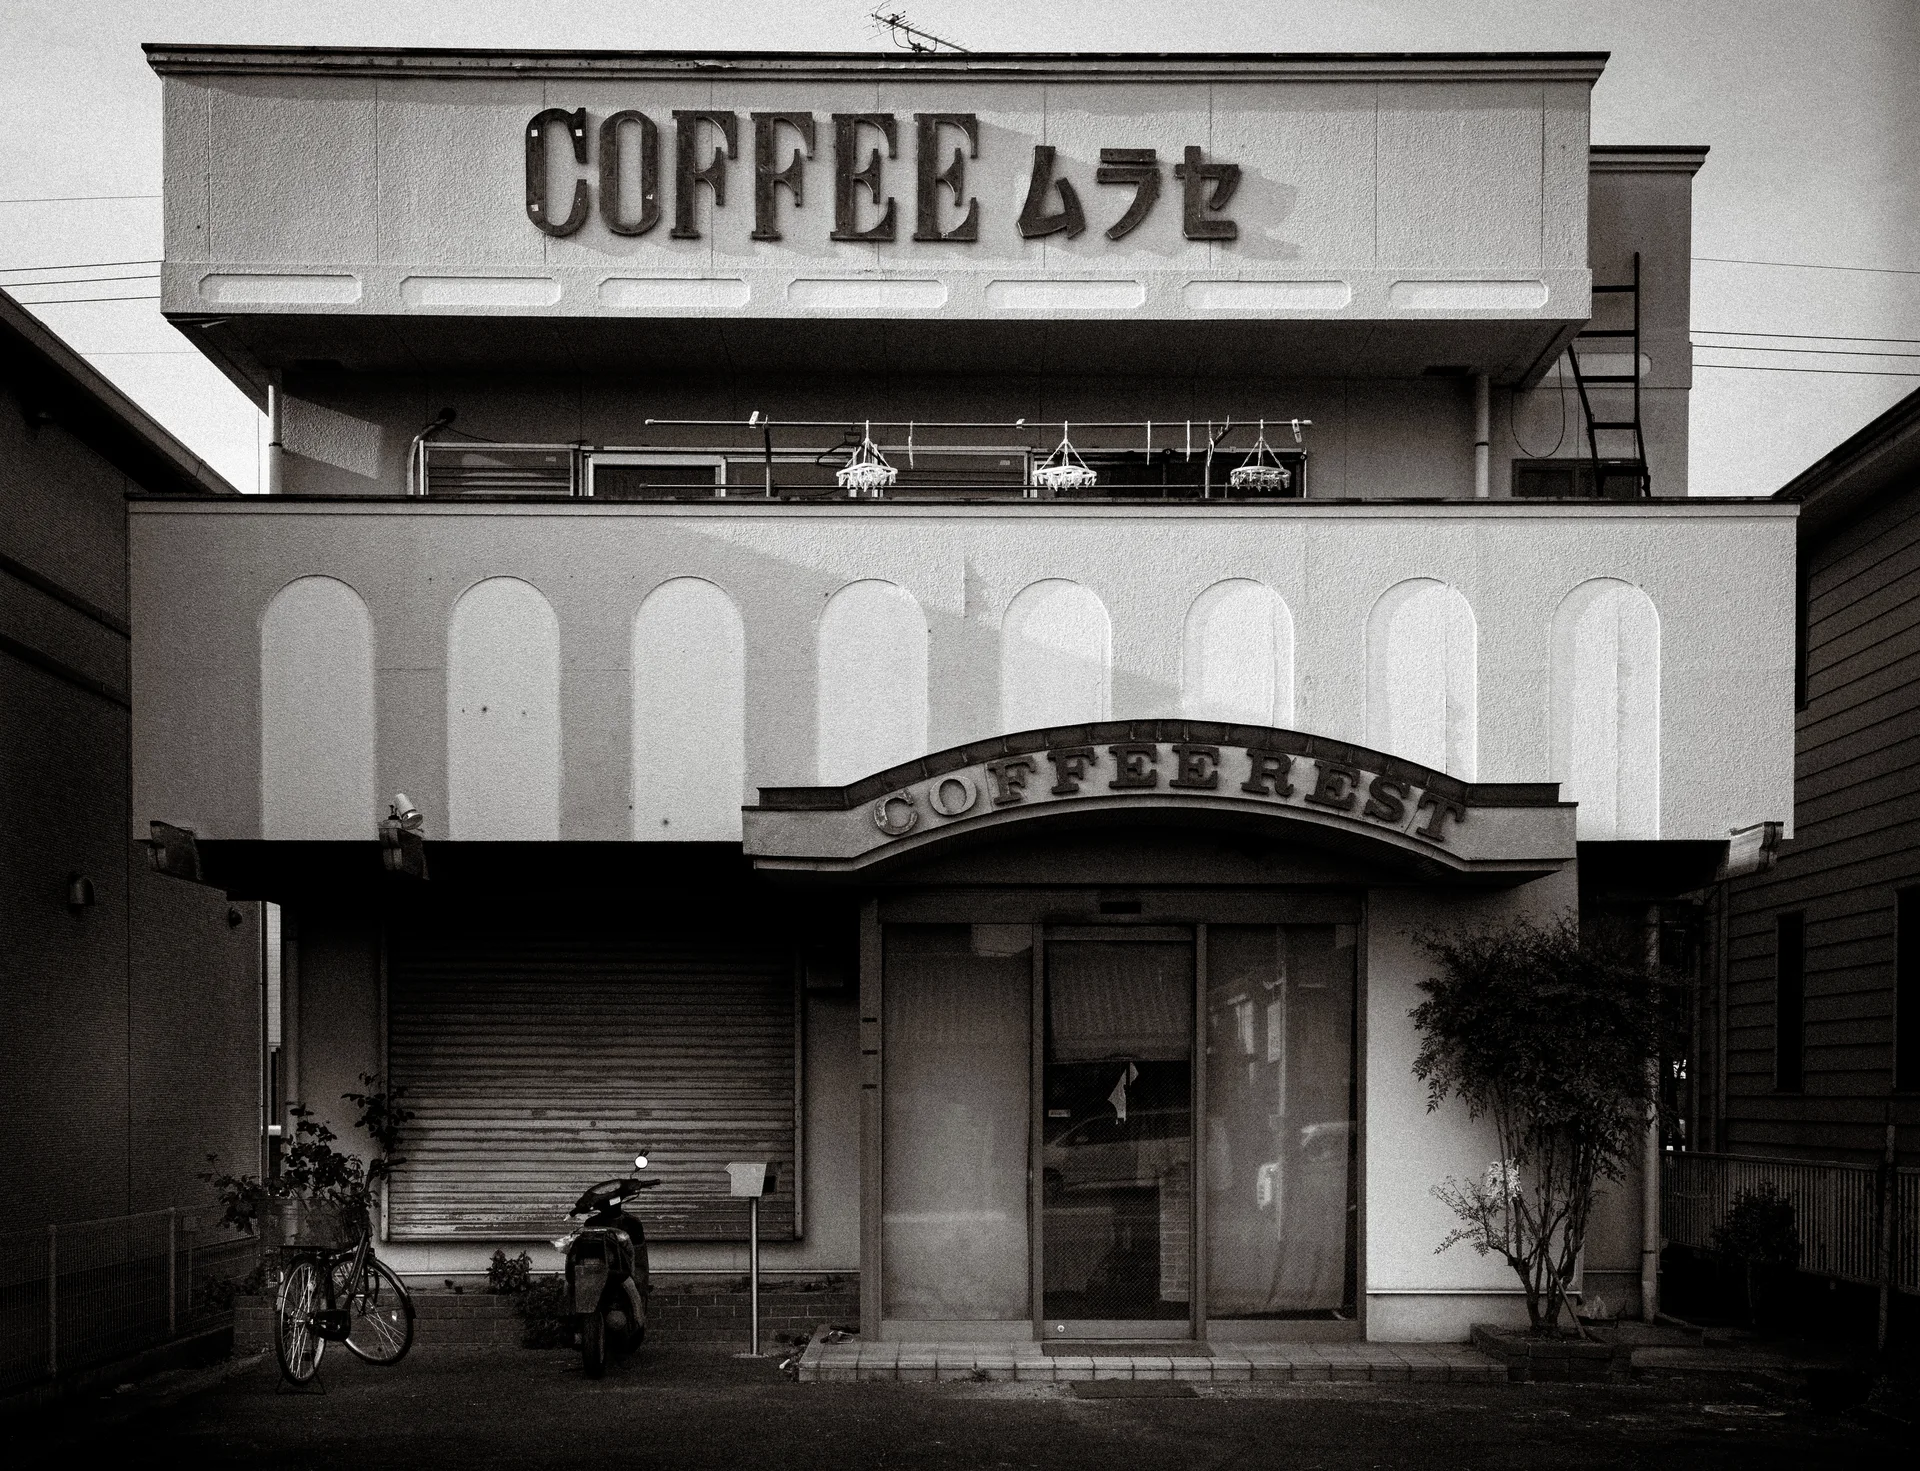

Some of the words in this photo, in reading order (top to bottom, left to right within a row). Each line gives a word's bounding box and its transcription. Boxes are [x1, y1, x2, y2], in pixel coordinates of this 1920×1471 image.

[525, 107, 979, 242] COFFEE
[1017, 145, 1241, 242] ムラセ
[872, 743, 1220, 837] COFFEE
[1240, 747, 1466, 842] REST
